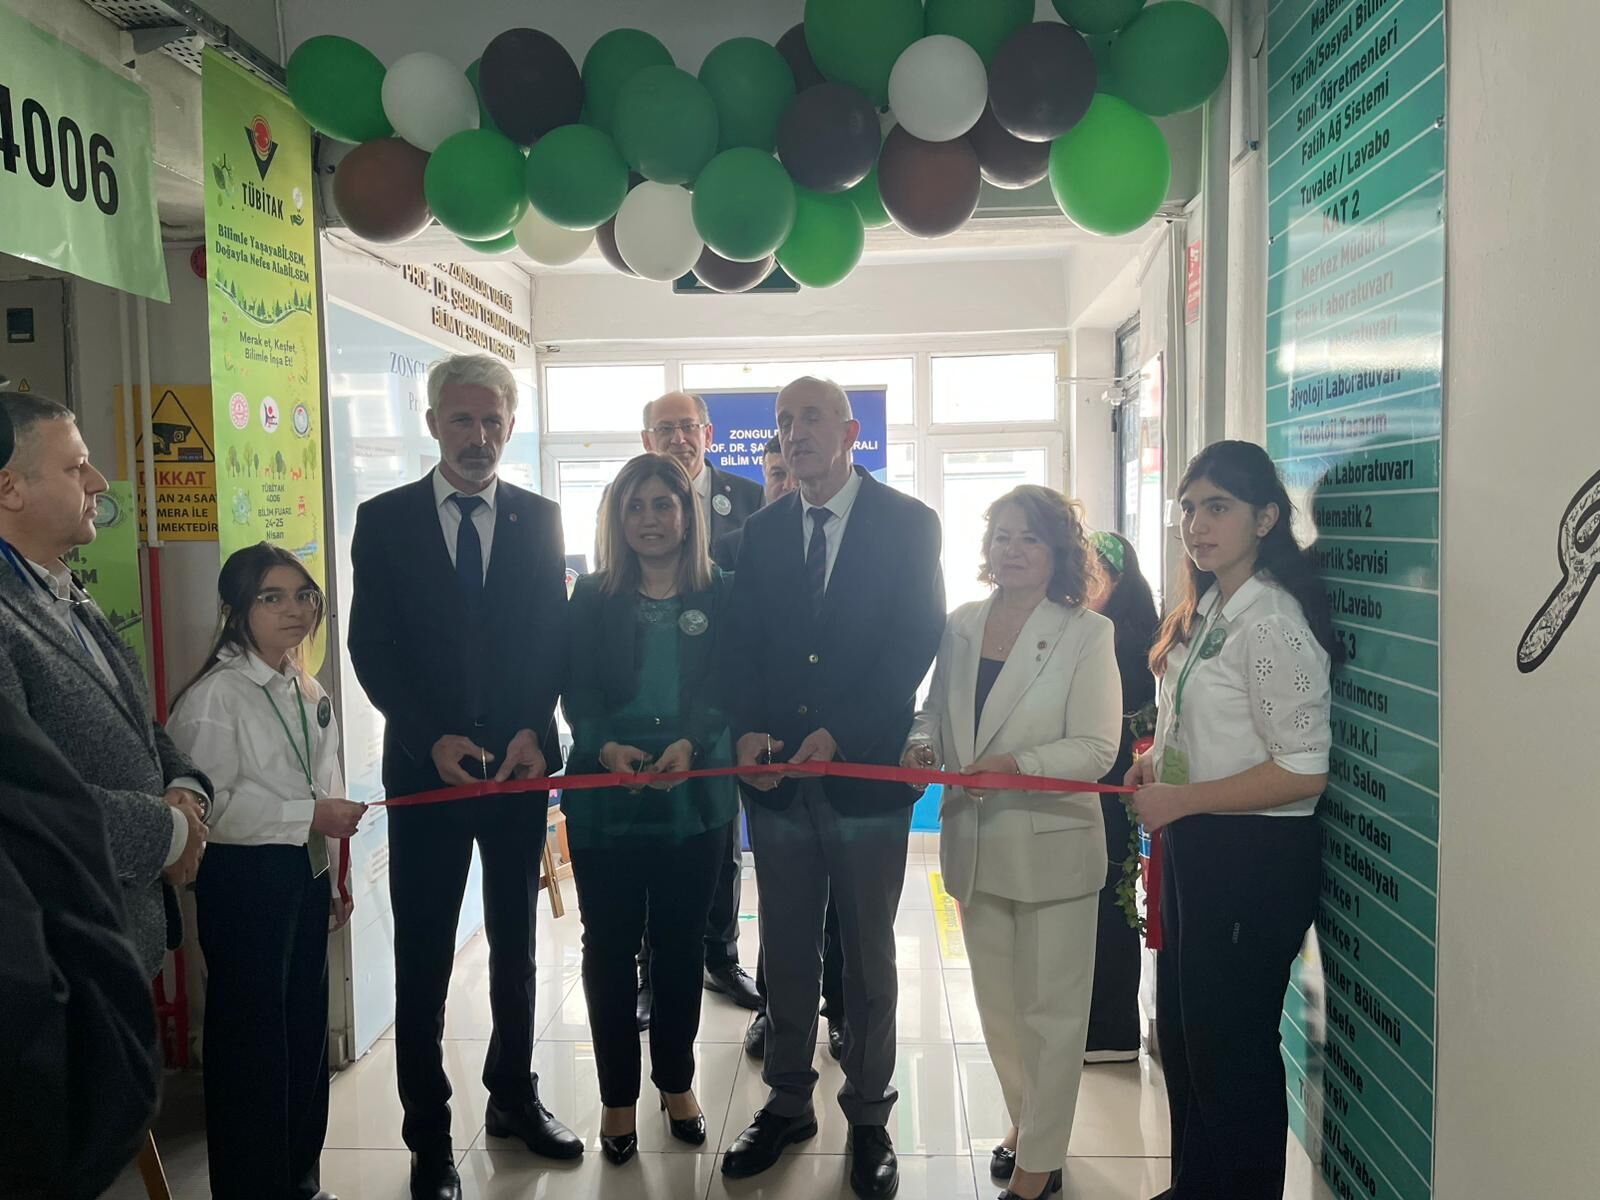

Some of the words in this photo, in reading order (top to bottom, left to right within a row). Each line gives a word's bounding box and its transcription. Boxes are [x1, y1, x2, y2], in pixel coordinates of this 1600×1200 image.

[1290, 14, 1352, 96] Tarih/Sosyal
[1297, 93, 1318, 132] Sınıf
[1320, 18, 1398, 110] Öğretmenleri
[1302, 128, 1325, 165] Fatih
[1328, 112, 1341, 145] Ağ
[1344, 72, 1389, 130] Sistemi
[1301, 170, 1337, 207] Tuvalet
[1348, 129, 1389, 174] Lavabo
[242, 181, 284, 221] TÜBİTAK
[1323, 197, 1348, 237] KAT
[1351, 189, 1360, 220] 2
[218, 223, 248, 246] Bilimle
[215, 240, 248, 263] Doğayla
[249, 252, 271, 270] Nefes
[1301, 255, 1338, 289] Merkez
[239, 330, 263, 346] Merak
[245, 348, 269, 362] Bilimle
[729, 429, 779, 440] ZONGUL
[729, 443, 747, 453] DR.
[853, 440, 878, 450] RALI
[720, 454, 749, 466] BİLİM
[1335, 459, 1413, 484] Laboratuvarı
[140, 508, 189, 517] KMERA
[192, 506, 208, 517] İLE
[177, 494, 190, 503] 24
[193, 494, 217, 503] SAA
[265, 518, 284, 528] 24-25
[1313, 506, 1361, 528] atematik
[1365, 504, 1372, 528] 2
[266, 531, 284, 540] Nisan
[1347, 548, 1388, 574] Servisi
[1327, 588, 1382, 620] et/Lavabo
[1349, 633, 1356, 660] 3
[1353, 764, 1386, 802] Salon
[1359, 814, 1391, 853] Odası
[1330, 838, 1341, 859] ve
[1344, 844, 1398, 903] Edebiyatı
[1320, 870, 1351, 911] ürkçe
[1355, 896, 1360, 918] 1
[1353, 936, 1360, 961] 2
[1326, 997, 1356, 1042] lsefe
[1354, 982, 1401, 1047] Bölümü
